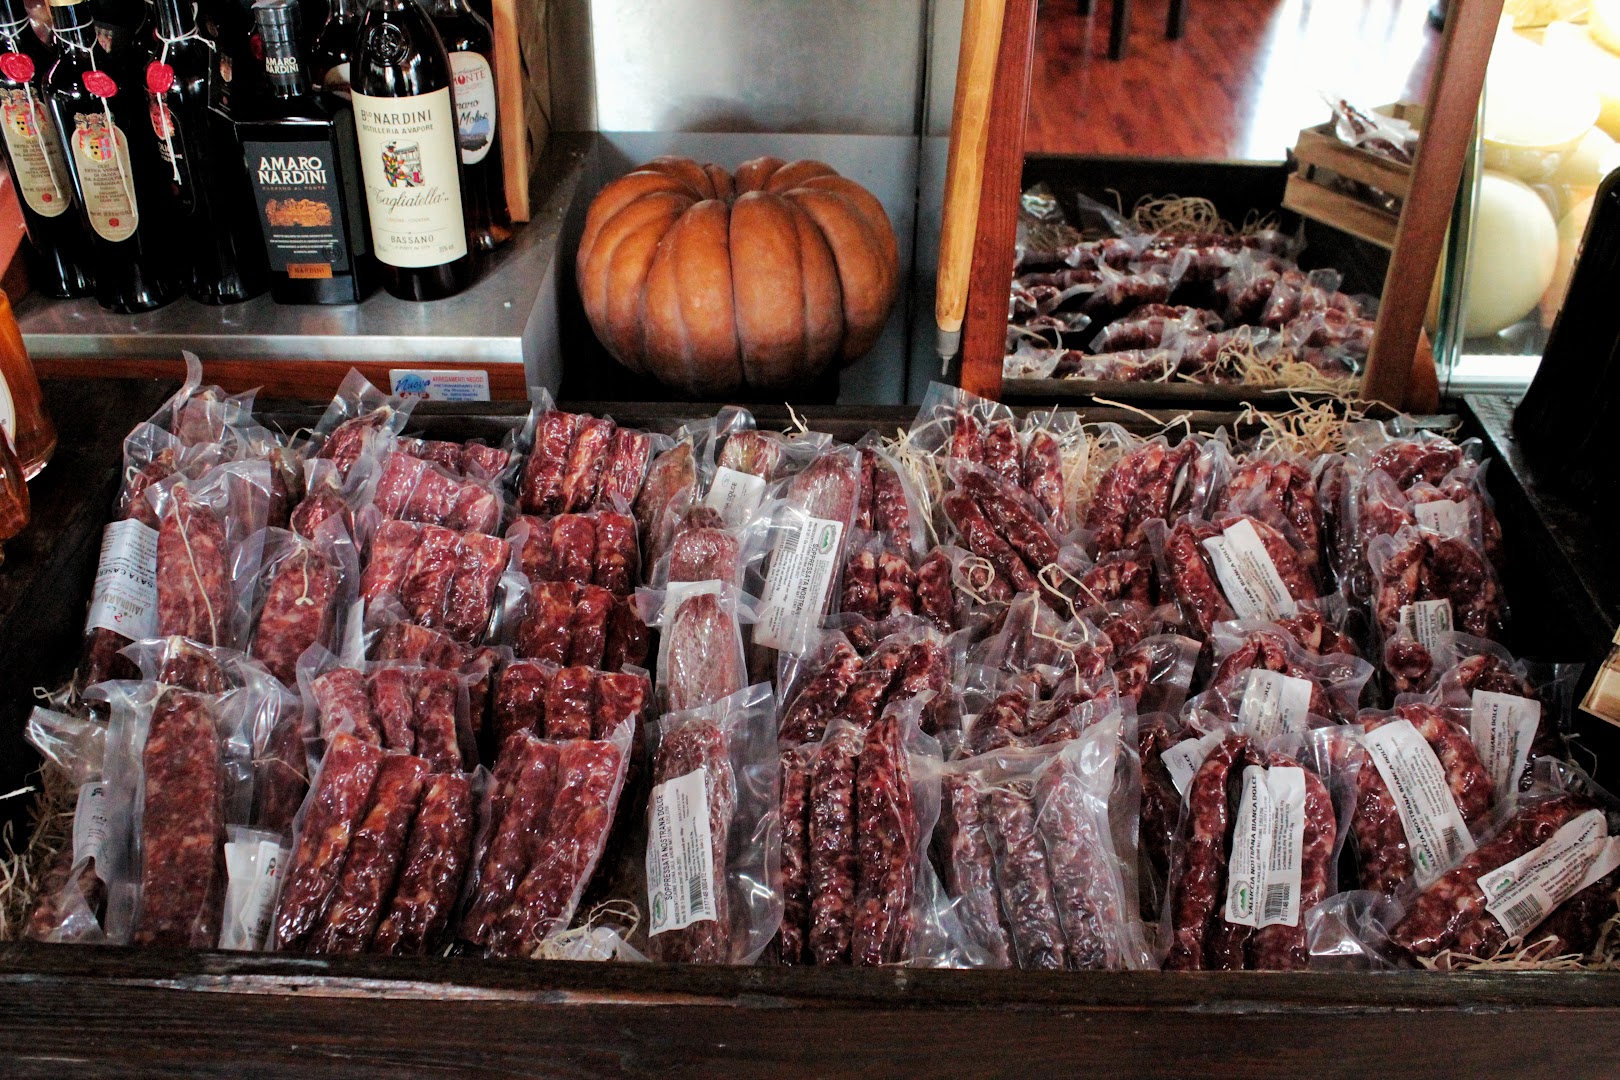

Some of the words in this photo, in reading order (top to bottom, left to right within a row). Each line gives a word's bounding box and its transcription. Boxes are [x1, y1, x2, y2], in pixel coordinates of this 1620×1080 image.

[265, 57, 297, 65] AMARO
[265, 64, 299, 74] NARDINI
[373, 109, 432, 125] NARDINI
[362, 125, 400, 134] DISTILLERIA
[260, 157, 322, 170] AMARO
[257, 170, 327, 184] NARDINI
[390, 234, 434, 244] BASSANO
[395, 379, 431, 392] Nuova
[725, 481, 737, 501] DOLCE
[802, 542, 818, 586] SOPPRESSATA
[1229, 562, 1245, 586] BIANCA
[1490, 702, 1498, 726] DOLCE
[1374, 741, 1391, 764] DOLCE
[1386, 764, 1404, 793] BIANCA
[656, 794, 664, 815] DOLCE
[1400, 793, 1422, 834] NOSTRANA
[657, 816, 667, 851] NOSTRANA
[661, 852, 672, 900] SOPPRESSATA
